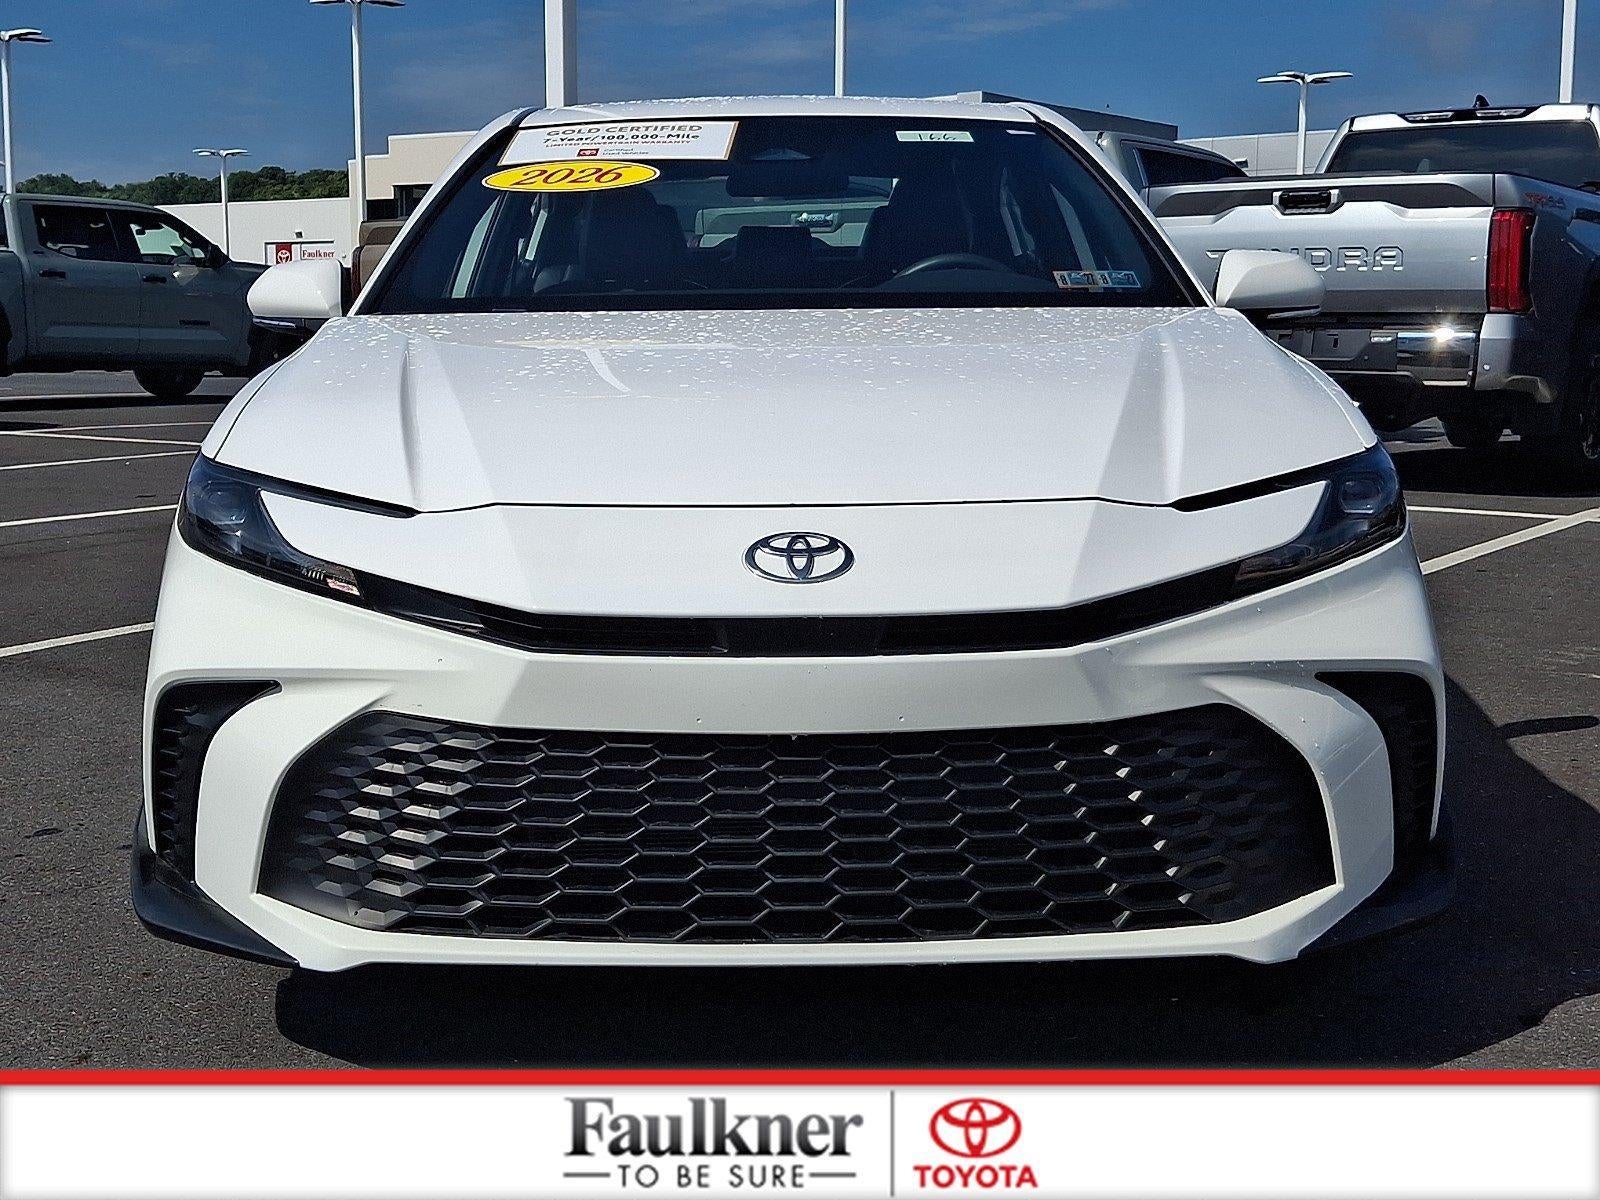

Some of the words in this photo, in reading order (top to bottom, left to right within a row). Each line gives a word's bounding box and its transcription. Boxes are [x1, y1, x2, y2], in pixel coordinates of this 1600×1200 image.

[547, 128, 601, 136] GOLD
[605, 125, 703, 133] CERTIFIED
[543, 133, 700, 143] 7-Year/100,000-Mile
[510, 165, 632, 186] 2026
[302, 249, 335, 258] Faulkner
